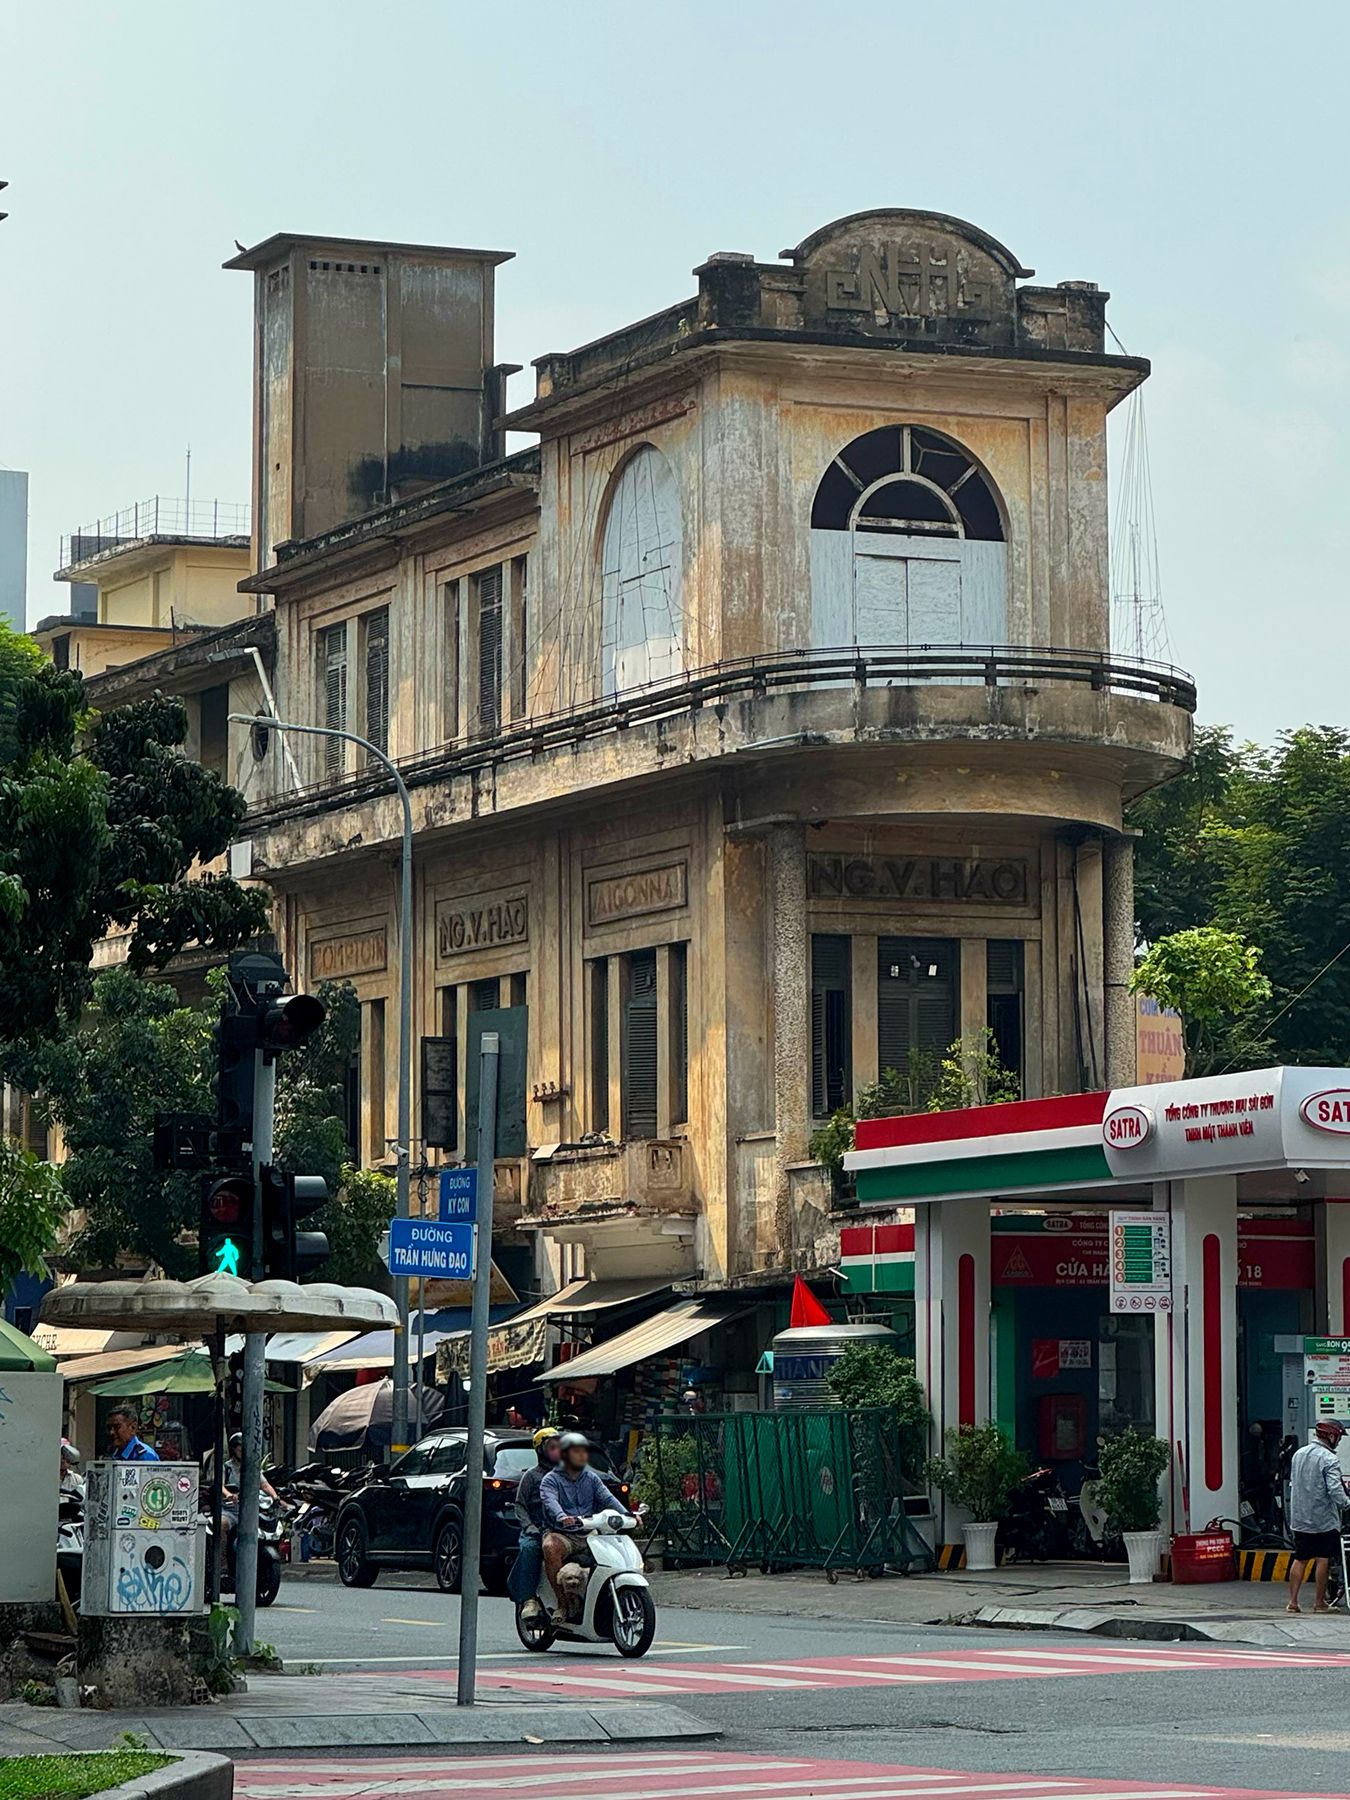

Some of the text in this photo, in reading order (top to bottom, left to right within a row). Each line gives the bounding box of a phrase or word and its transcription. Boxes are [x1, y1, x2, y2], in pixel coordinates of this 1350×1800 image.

[811, 860, 1018, 898] NG.V.HAO
[440, 900, 527, 952] NG.V.HAO
[1200, 1103, 1209, 1118] TY
[1109, 1117, 1141, 1140] SATRA
[457, 1197, 470, 1214] CON
[411, 1226, 453, 1243] ĐƯỜNG
[394, 1243, 467, 1274] TRẦN HƯNG ĐẠO
[1055, 1257, 1089, 1277] CỬA
[1246, 1265, 1262, 1279] 18
